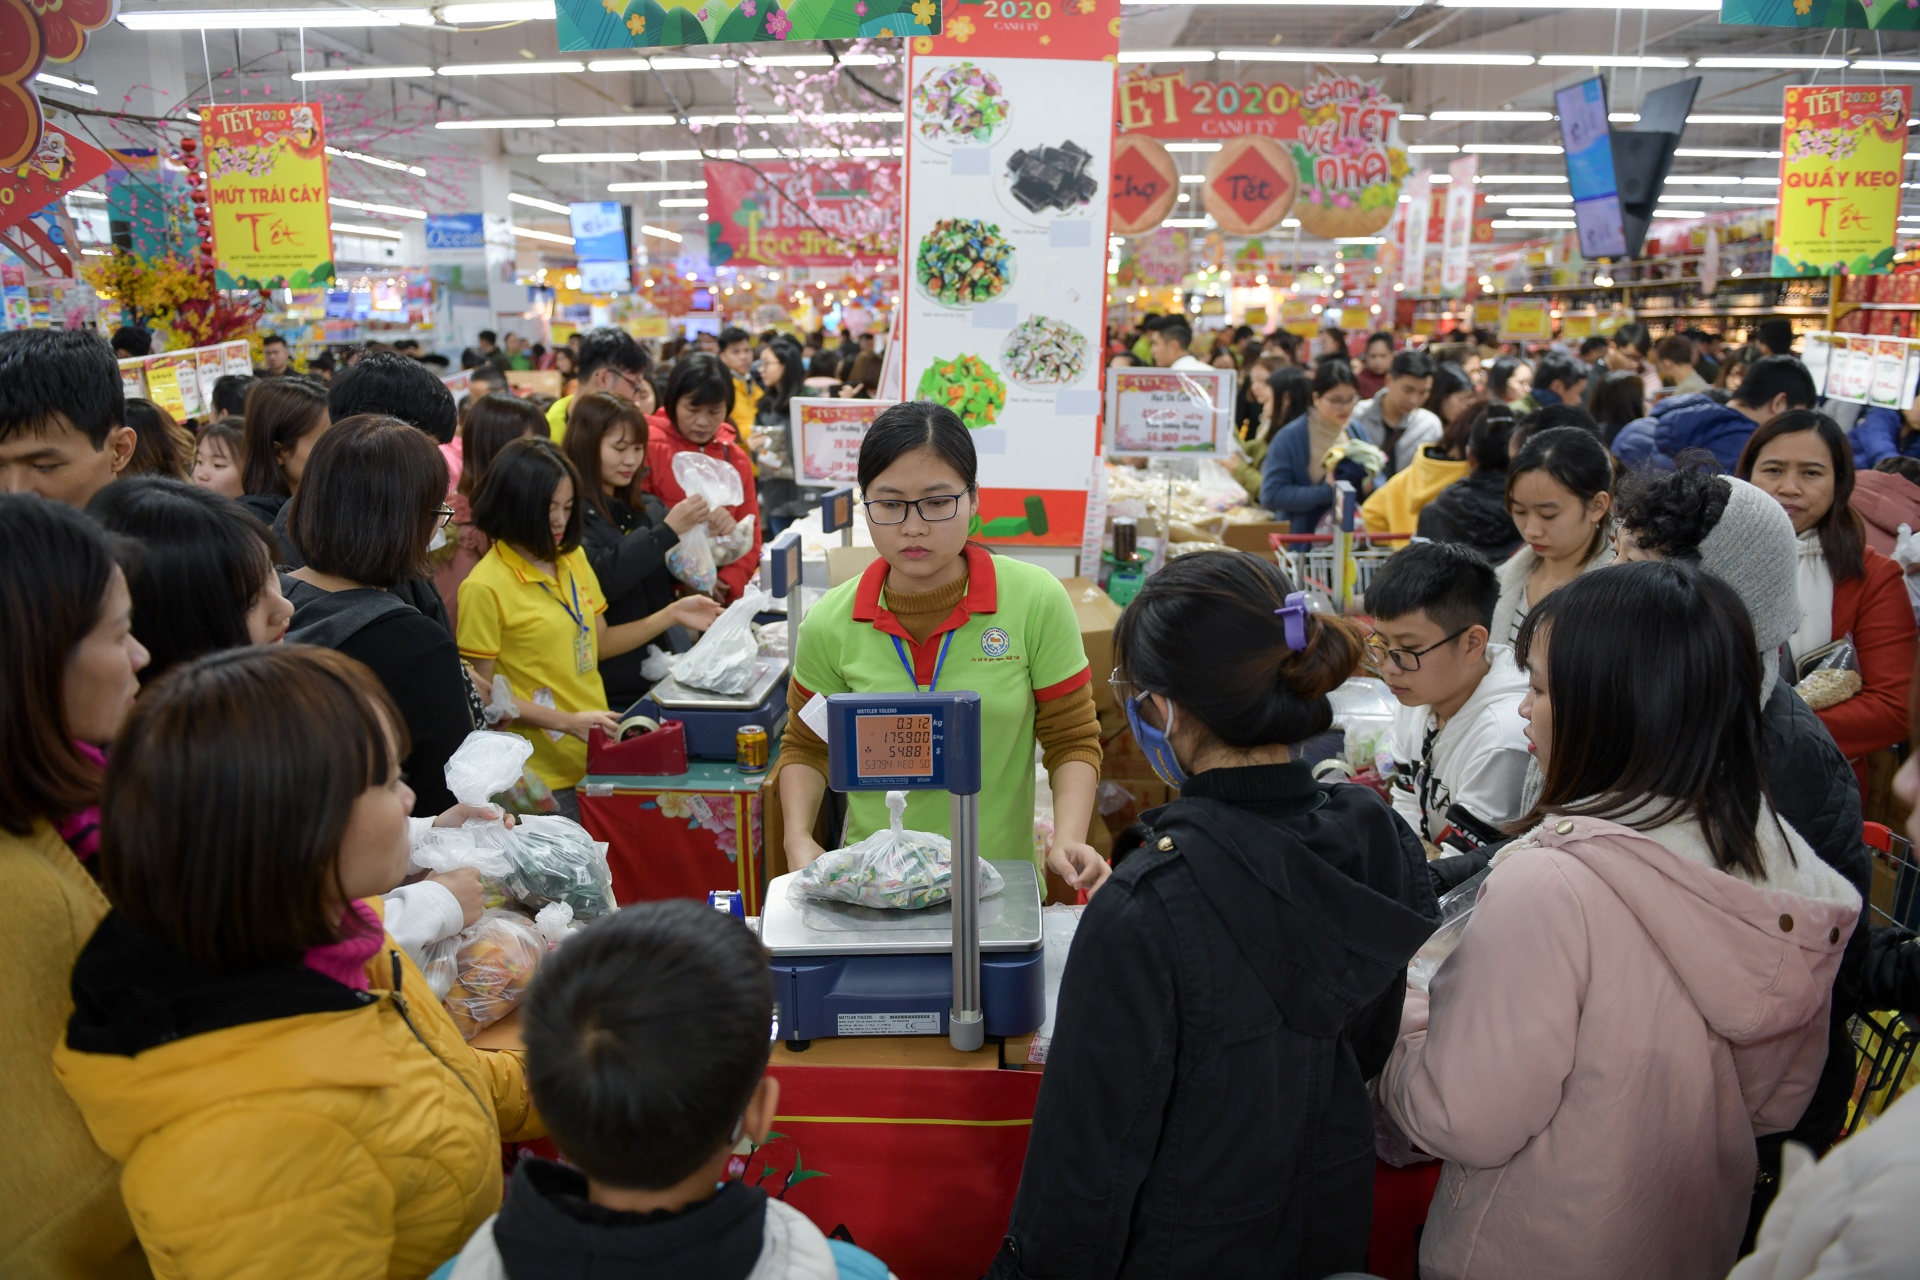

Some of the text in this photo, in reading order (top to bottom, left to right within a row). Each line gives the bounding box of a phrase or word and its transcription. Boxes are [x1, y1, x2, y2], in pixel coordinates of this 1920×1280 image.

[984, 0, 1052, 20] 2020
[1192, 85, 1292, 115] 2020
[1803, 88, 1878, 117] TẾT 2020
[217, 105, 287, 135] TẾT 2020
[1854, 170, 1898, 192] KẸO
[213, 183, 323, 205] MỨT TRÁI CÂY
[896, 718, 930, 730] 0.312
[932, 720, 943, 728] kg
[884, 731, 930, 743] 175.900
[889, 746, 930, 758] 54.881
